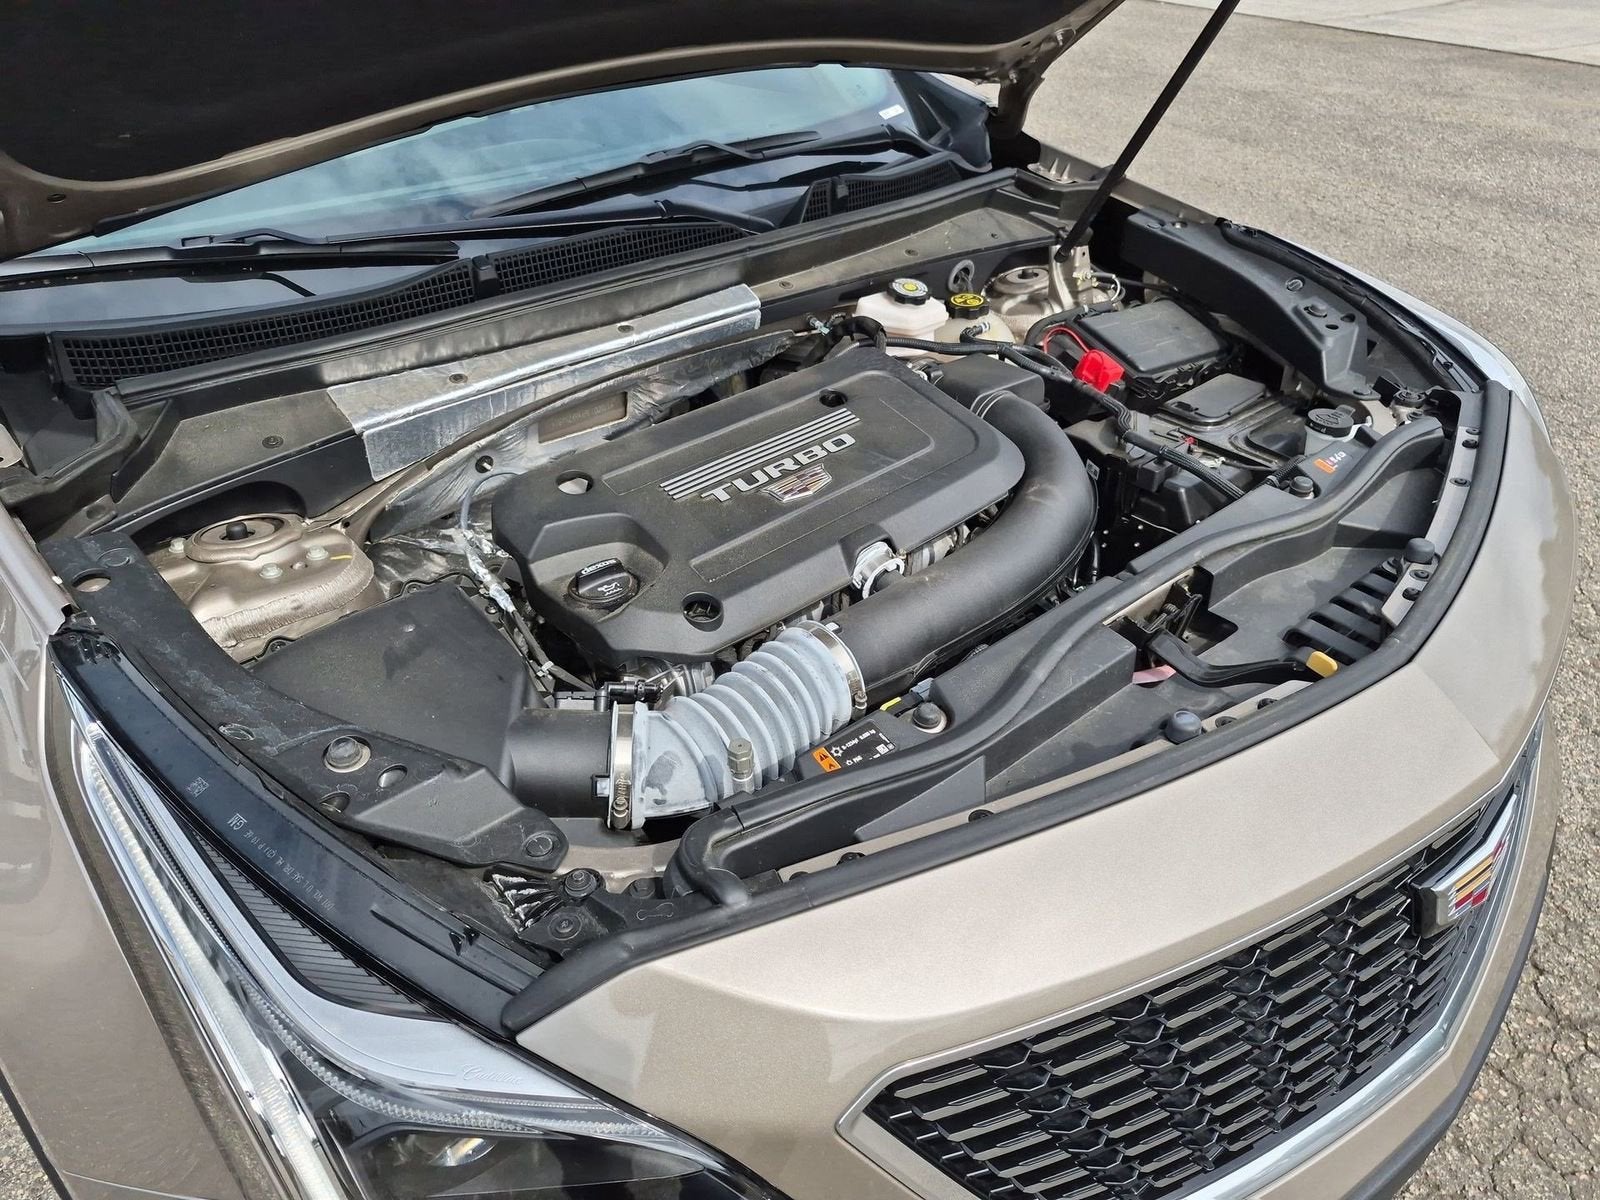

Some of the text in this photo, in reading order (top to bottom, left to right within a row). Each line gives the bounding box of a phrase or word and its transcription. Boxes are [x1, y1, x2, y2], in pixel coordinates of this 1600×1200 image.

[700, 433, 856, 503] TURBO
[581, 559, 616, 575] dexos
[227, 813, 247, 830] GM
